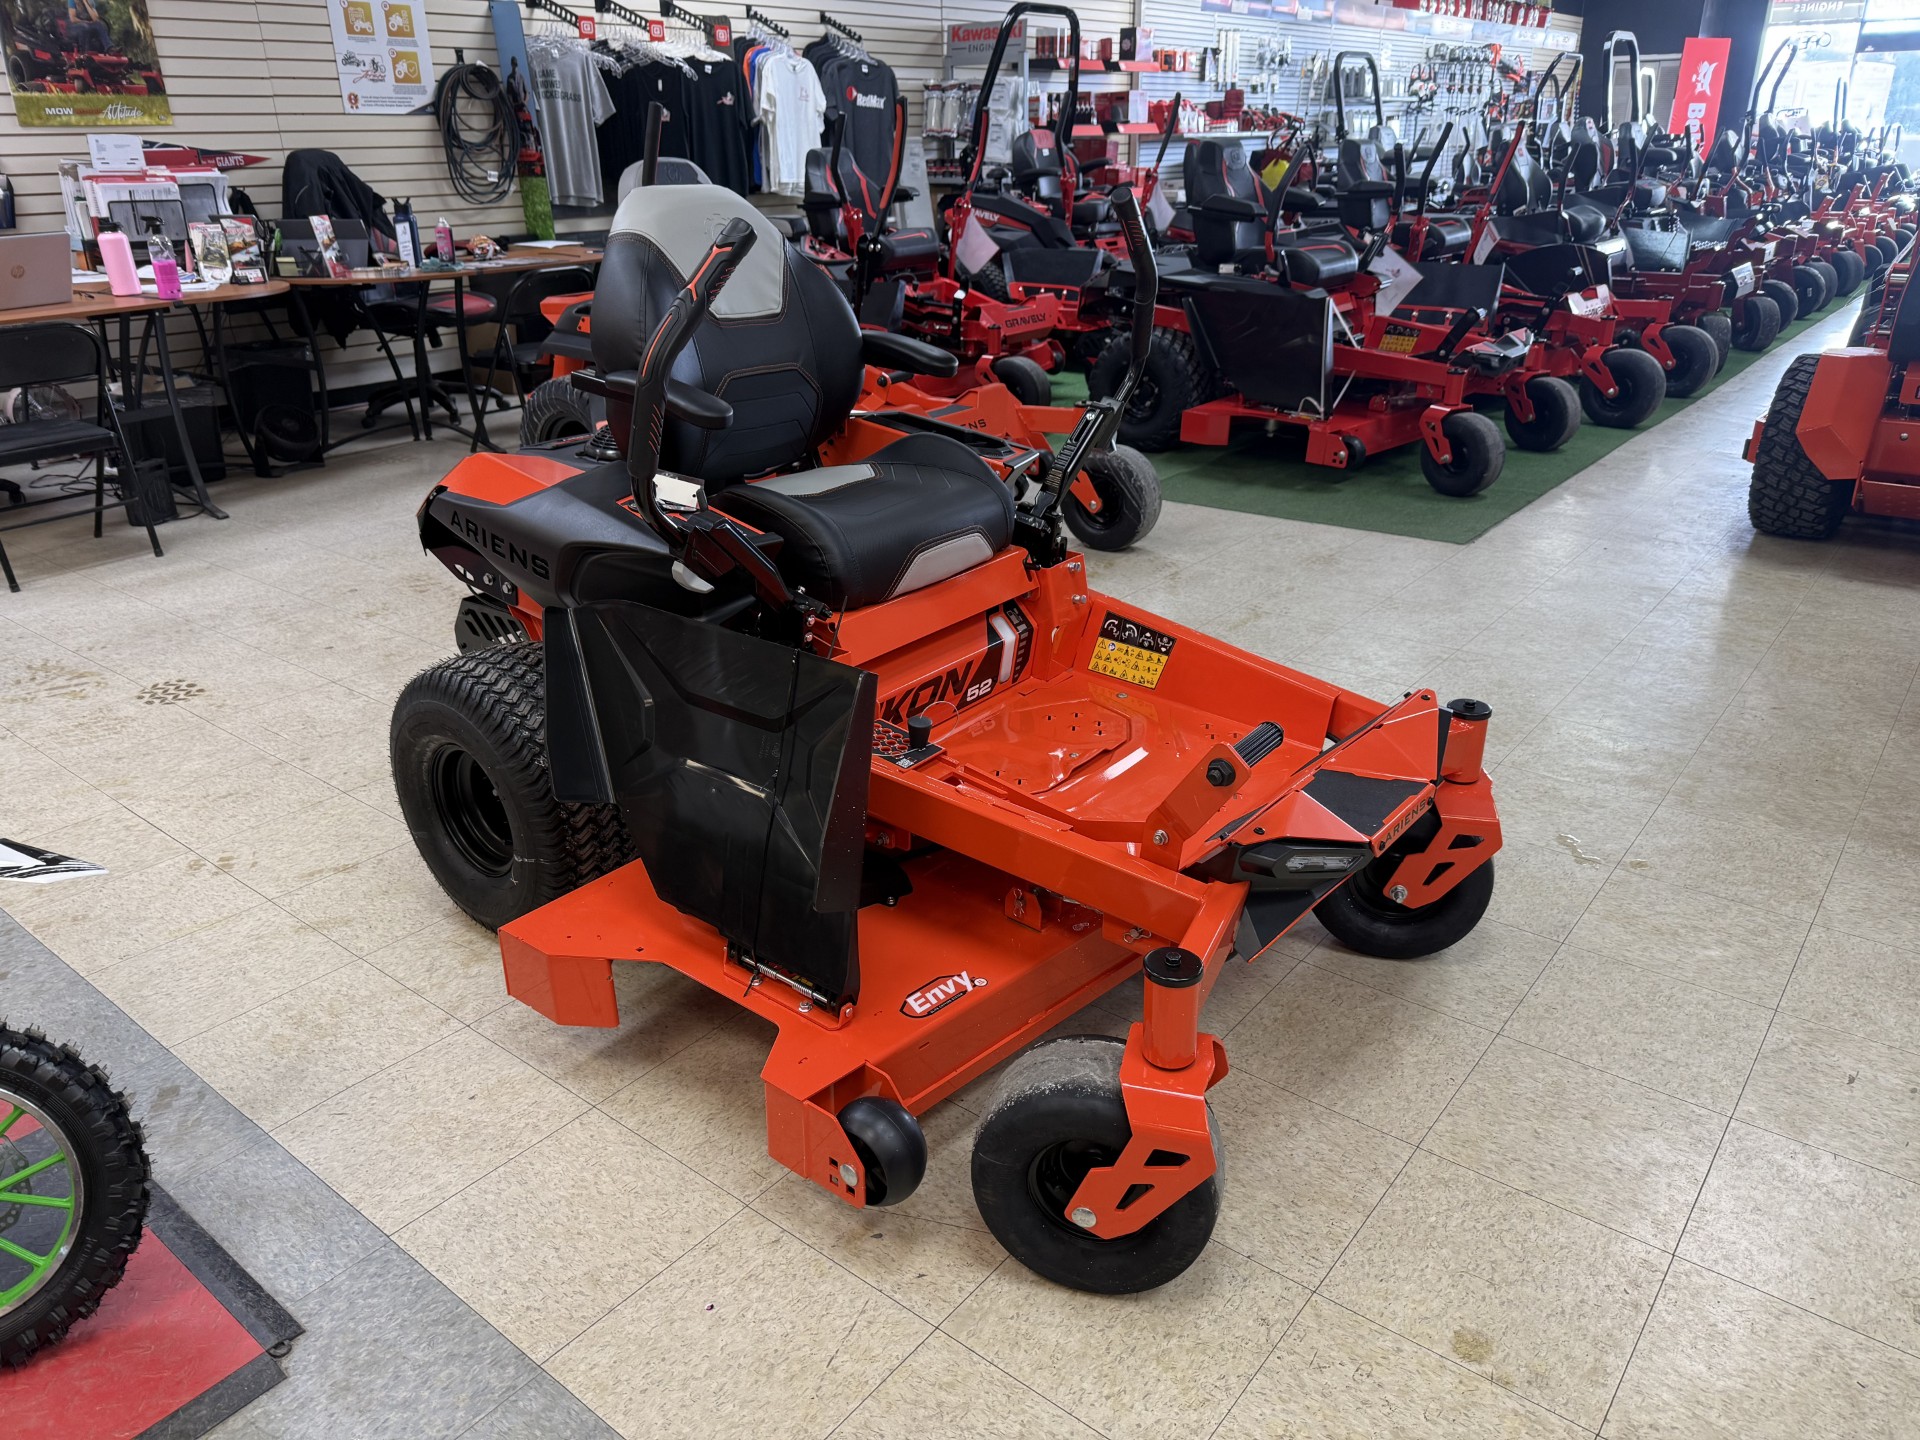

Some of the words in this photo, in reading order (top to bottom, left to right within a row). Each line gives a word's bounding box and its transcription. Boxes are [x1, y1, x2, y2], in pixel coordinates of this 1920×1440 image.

[951, 21, 1023, 43] Kawaski
[45, 107, 74, 115] MOW
[102, 101, 144, 120] Attitude
[856, 93, 885, 109] RedMax
[215, 155, 245, 167] GIANTS
[1004, 312, 1046, 329] GRAVELY
[450, 510, 550, 580] ARIENS
[879, 659, 975, 725] KON
[966, 677, 993, 702] 52
[1384, 800, 1426, 842] ARIENS
[906, 971, 973, 1014] Envy
